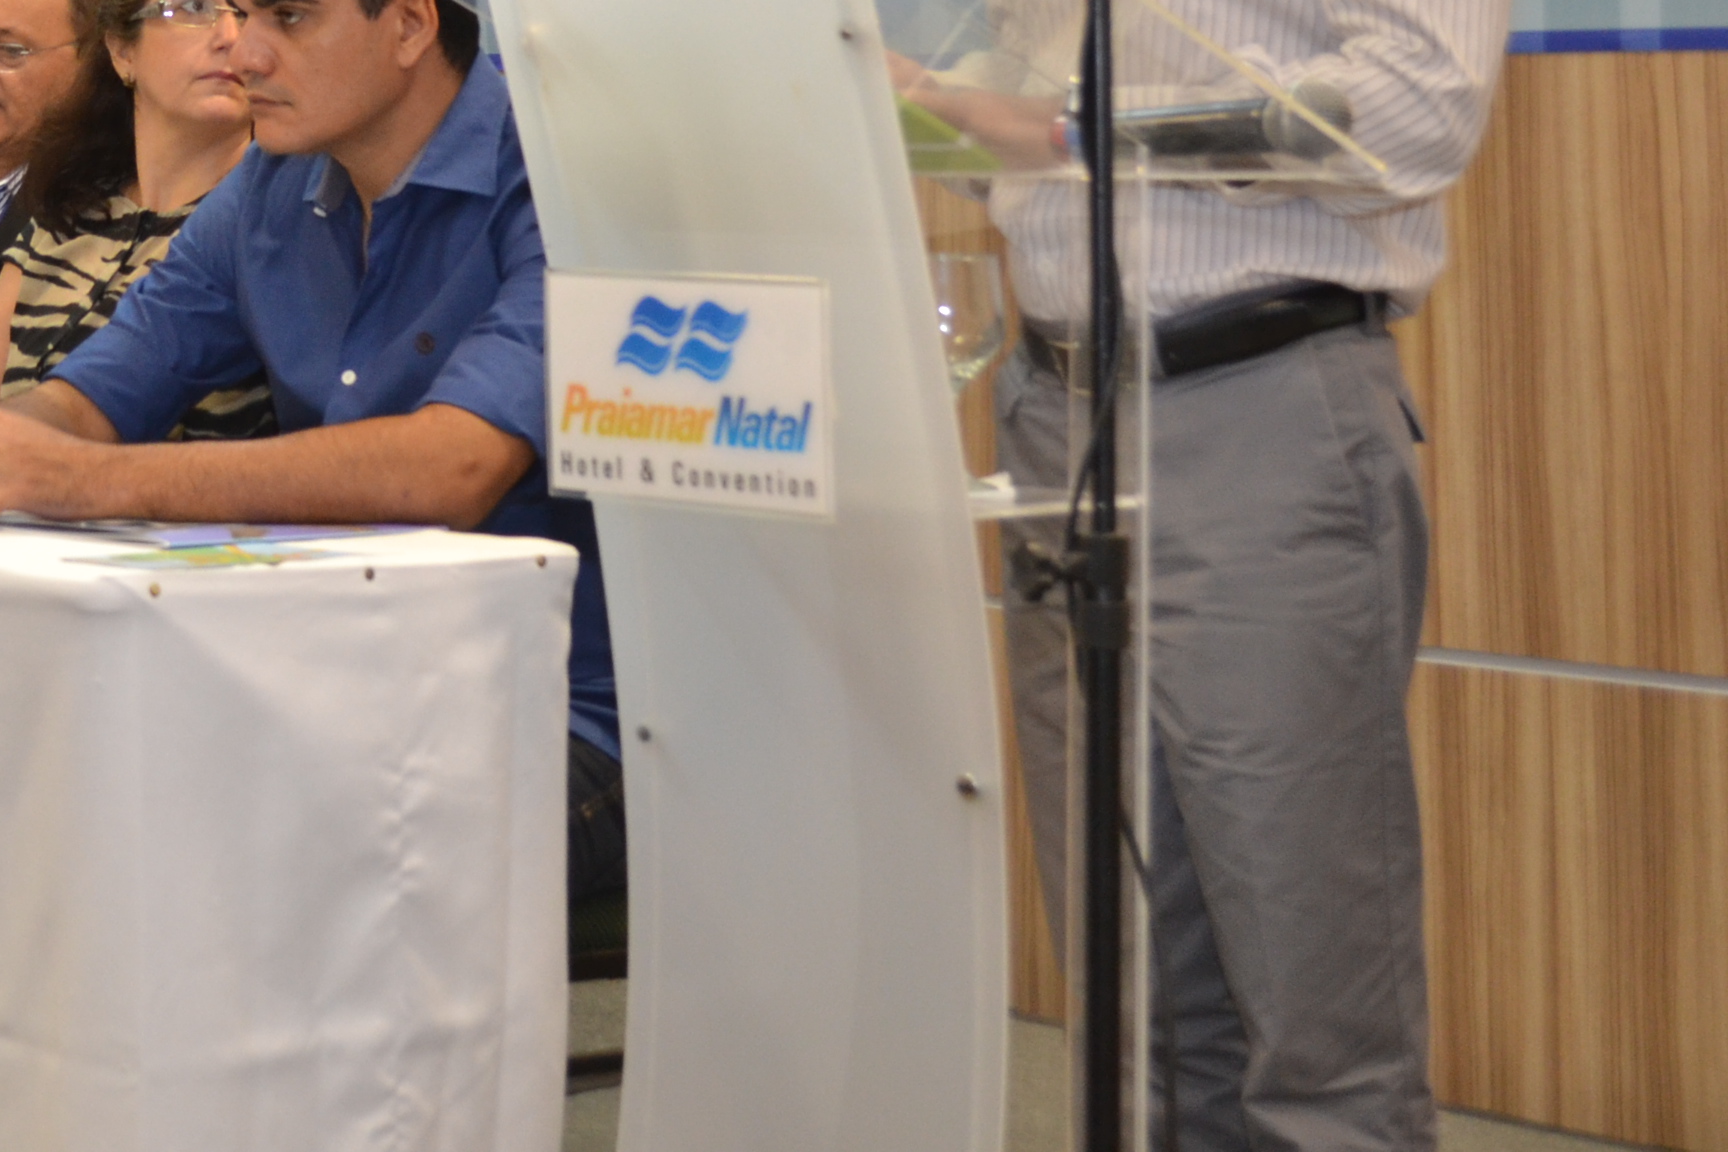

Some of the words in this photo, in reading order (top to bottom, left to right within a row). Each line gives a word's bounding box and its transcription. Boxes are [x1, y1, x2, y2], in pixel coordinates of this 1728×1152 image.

[713, 394, 813, 453] Natal
[559, 450, 622, 480] Hotel
[639, 456, 655, 484] &
[671, 460, 817, 498] Convention
